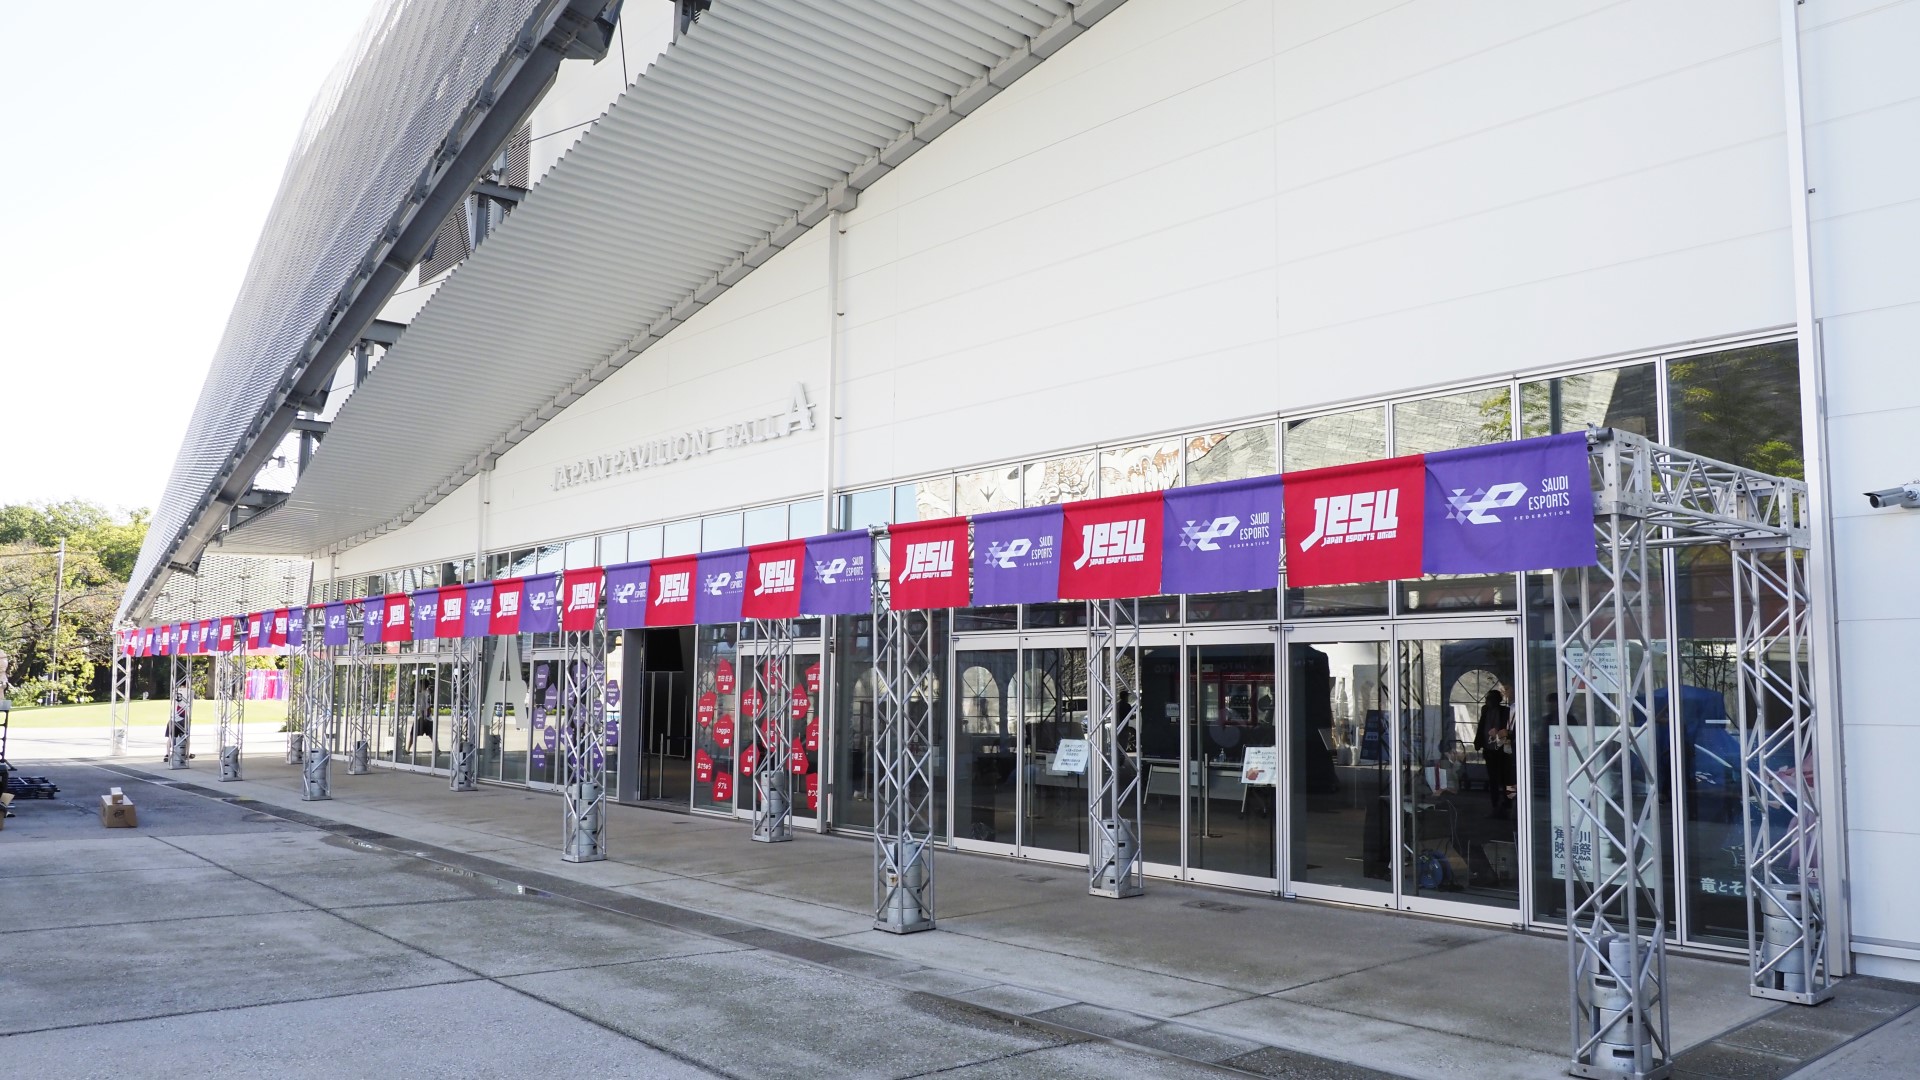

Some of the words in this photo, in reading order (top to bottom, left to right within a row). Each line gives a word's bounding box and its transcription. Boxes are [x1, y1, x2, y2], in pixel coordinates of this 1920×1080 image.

[551, 454, 609, 491] JAPAN
[609, 427, 710, 476] PAVILION
[723, 413, 780, 449] HALL
[783, 382, 816, 436] A
[1541, 475, 1569, 493] SAUDI
[1528, 492, 1570, 511] ESPORTS
[1250, 511, 1270, 526] SAUDI
[1300, 488, 1399, 553] JESU
[1514, 509, 1571, 521] FEDERATION
[1239, 525, 1270, 541] ESPORTS
[1073, 518, 1146, 571] JESU
